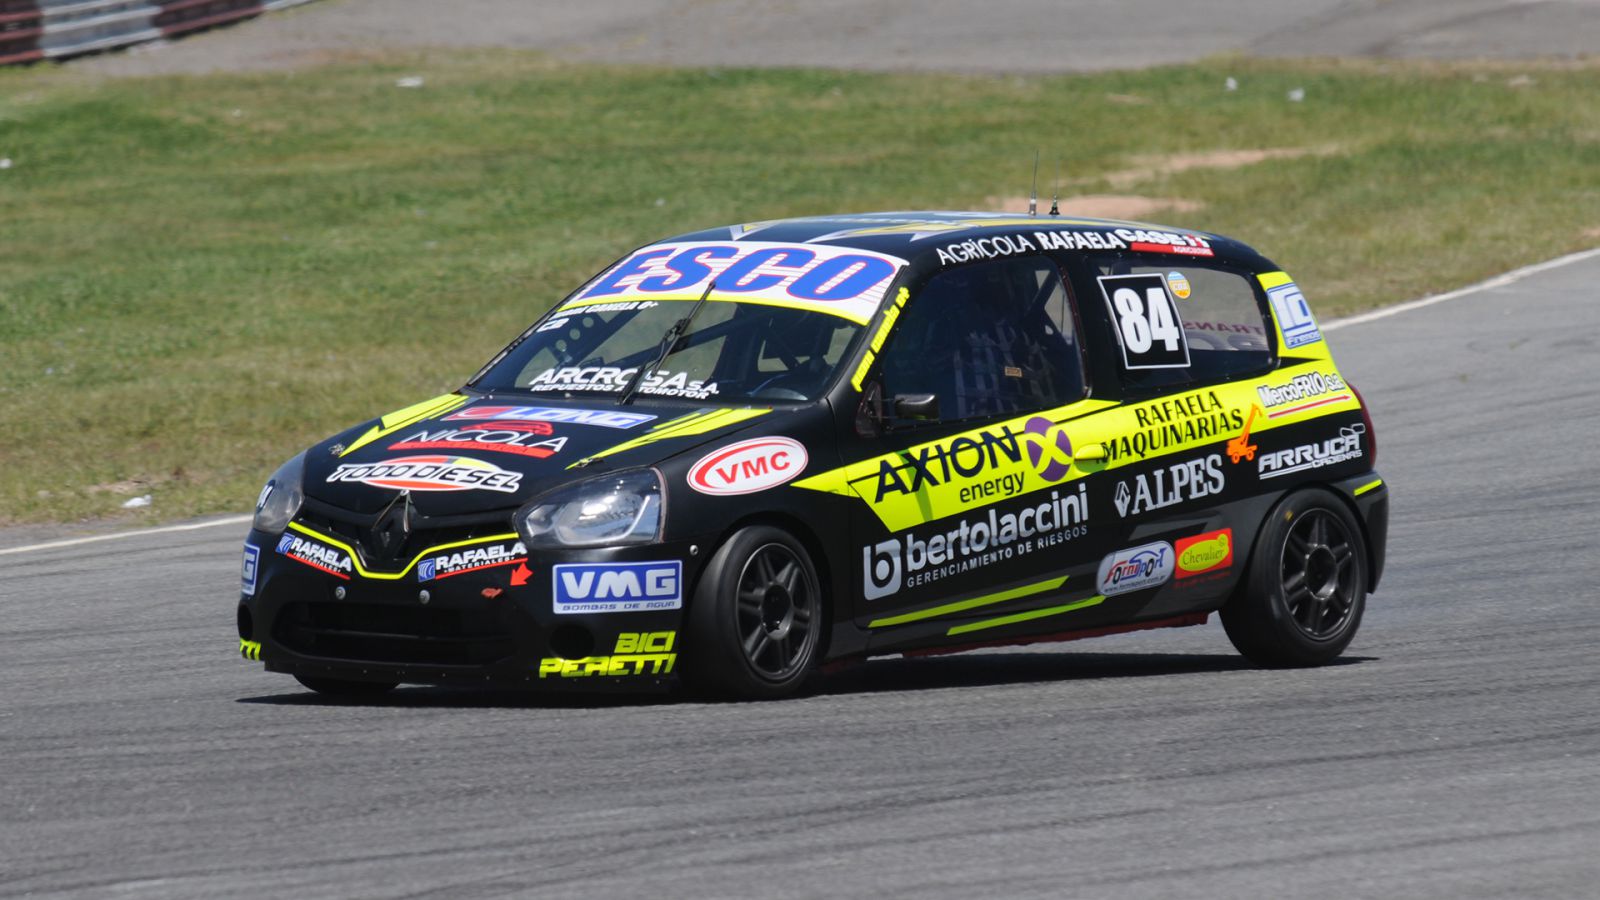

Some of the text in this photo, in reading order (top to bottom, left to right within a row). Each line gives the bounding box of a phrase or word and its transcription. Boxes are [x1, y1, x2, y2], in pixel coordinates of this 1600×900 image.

[1034, 230, 1127, 250] RAFAELA
[578, 245, 896, 302] ESCO
[1113, 287, 1180, 354] 84
[531, 384, 615, 392] REPUESTOS
[1257, 371, 1327, 408] MercoFRIO
[1135, 391, 1223, 428] RAFAELA
[400, 430, 569, 453] NICOLA
[1101, 408, 1244, 462] MAQUINARIAS
[715, 451, 791, 484] VMC
[875, 426, 1022, 504] AXION
[1259, 434, 1360, 473] ARRUCA
[1311, 449, 1363, 469] CADENAS
[959, 472, 1025, 503] energy
[1131, 454, 1225, 514] ALPES
[906, 482, 1089, 573] bertolaccini
[291, 537, 352, 572] RAFAELA
[436, 542, 528, 570] RAFAELA
[907, 525, 1088, 588] GERENCIAMIENTO DE RIESGOS
[1182, 546, 1225, 566] Chevalier
[561, 568, 676, 599] VMG
[562, 603, 617, 611] BOMBAS
[614, 631, 677, 653] BICI
[538, 653, 677, 678] PERETTI
